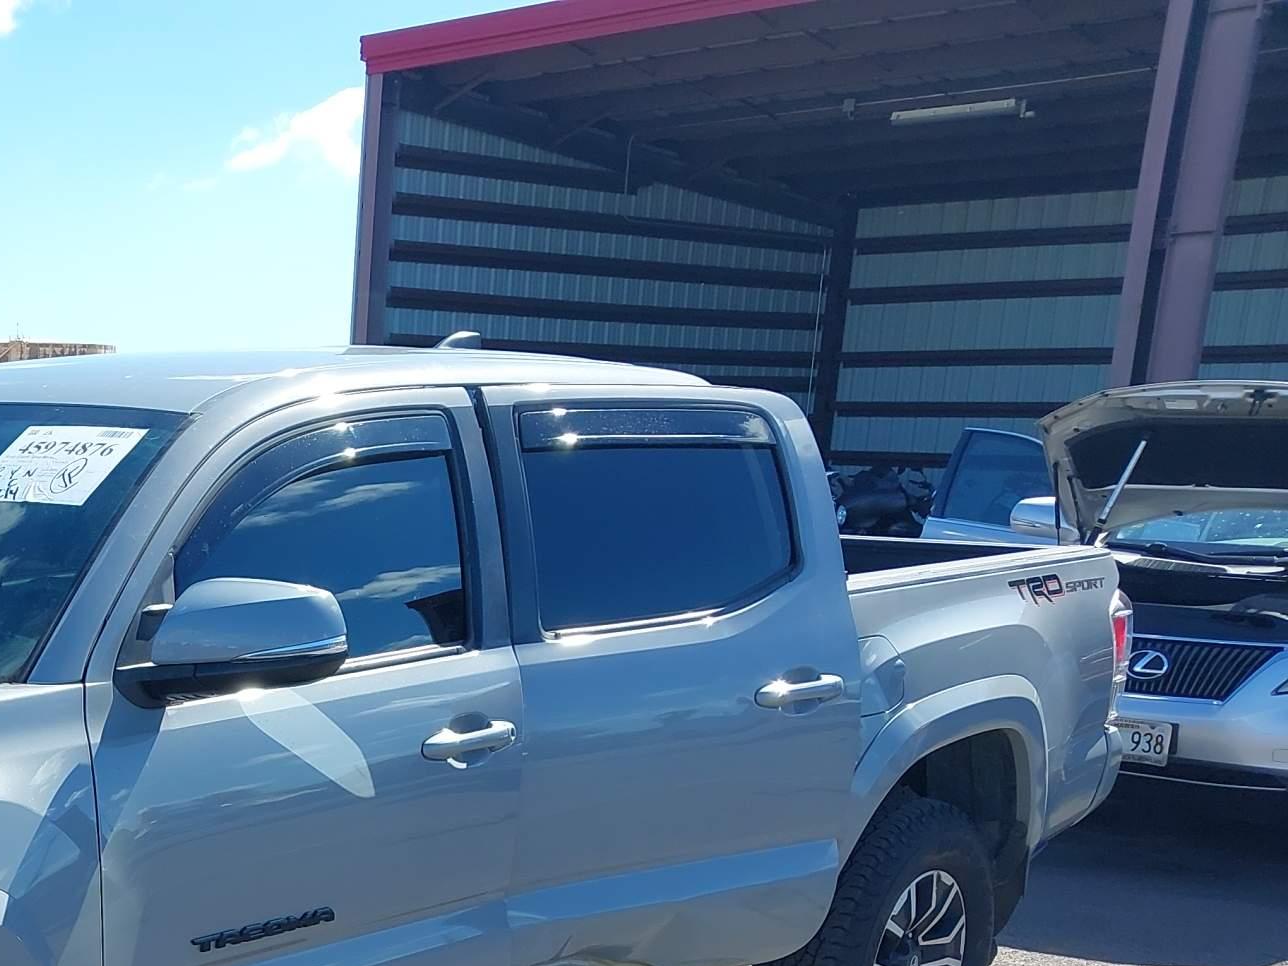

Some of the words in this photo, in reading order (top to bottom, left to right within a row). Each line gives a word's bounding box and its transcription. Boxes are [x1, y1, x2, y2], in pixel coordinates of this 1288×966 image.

[18, 441, 120, 457] 45974876
[1007, 573, 1065, 607] TRD
[1065, 577, 1105, 593] SPORT
[1130, 730, 1164, 755] 938
[190, 906, 335, 952] TACOMA
